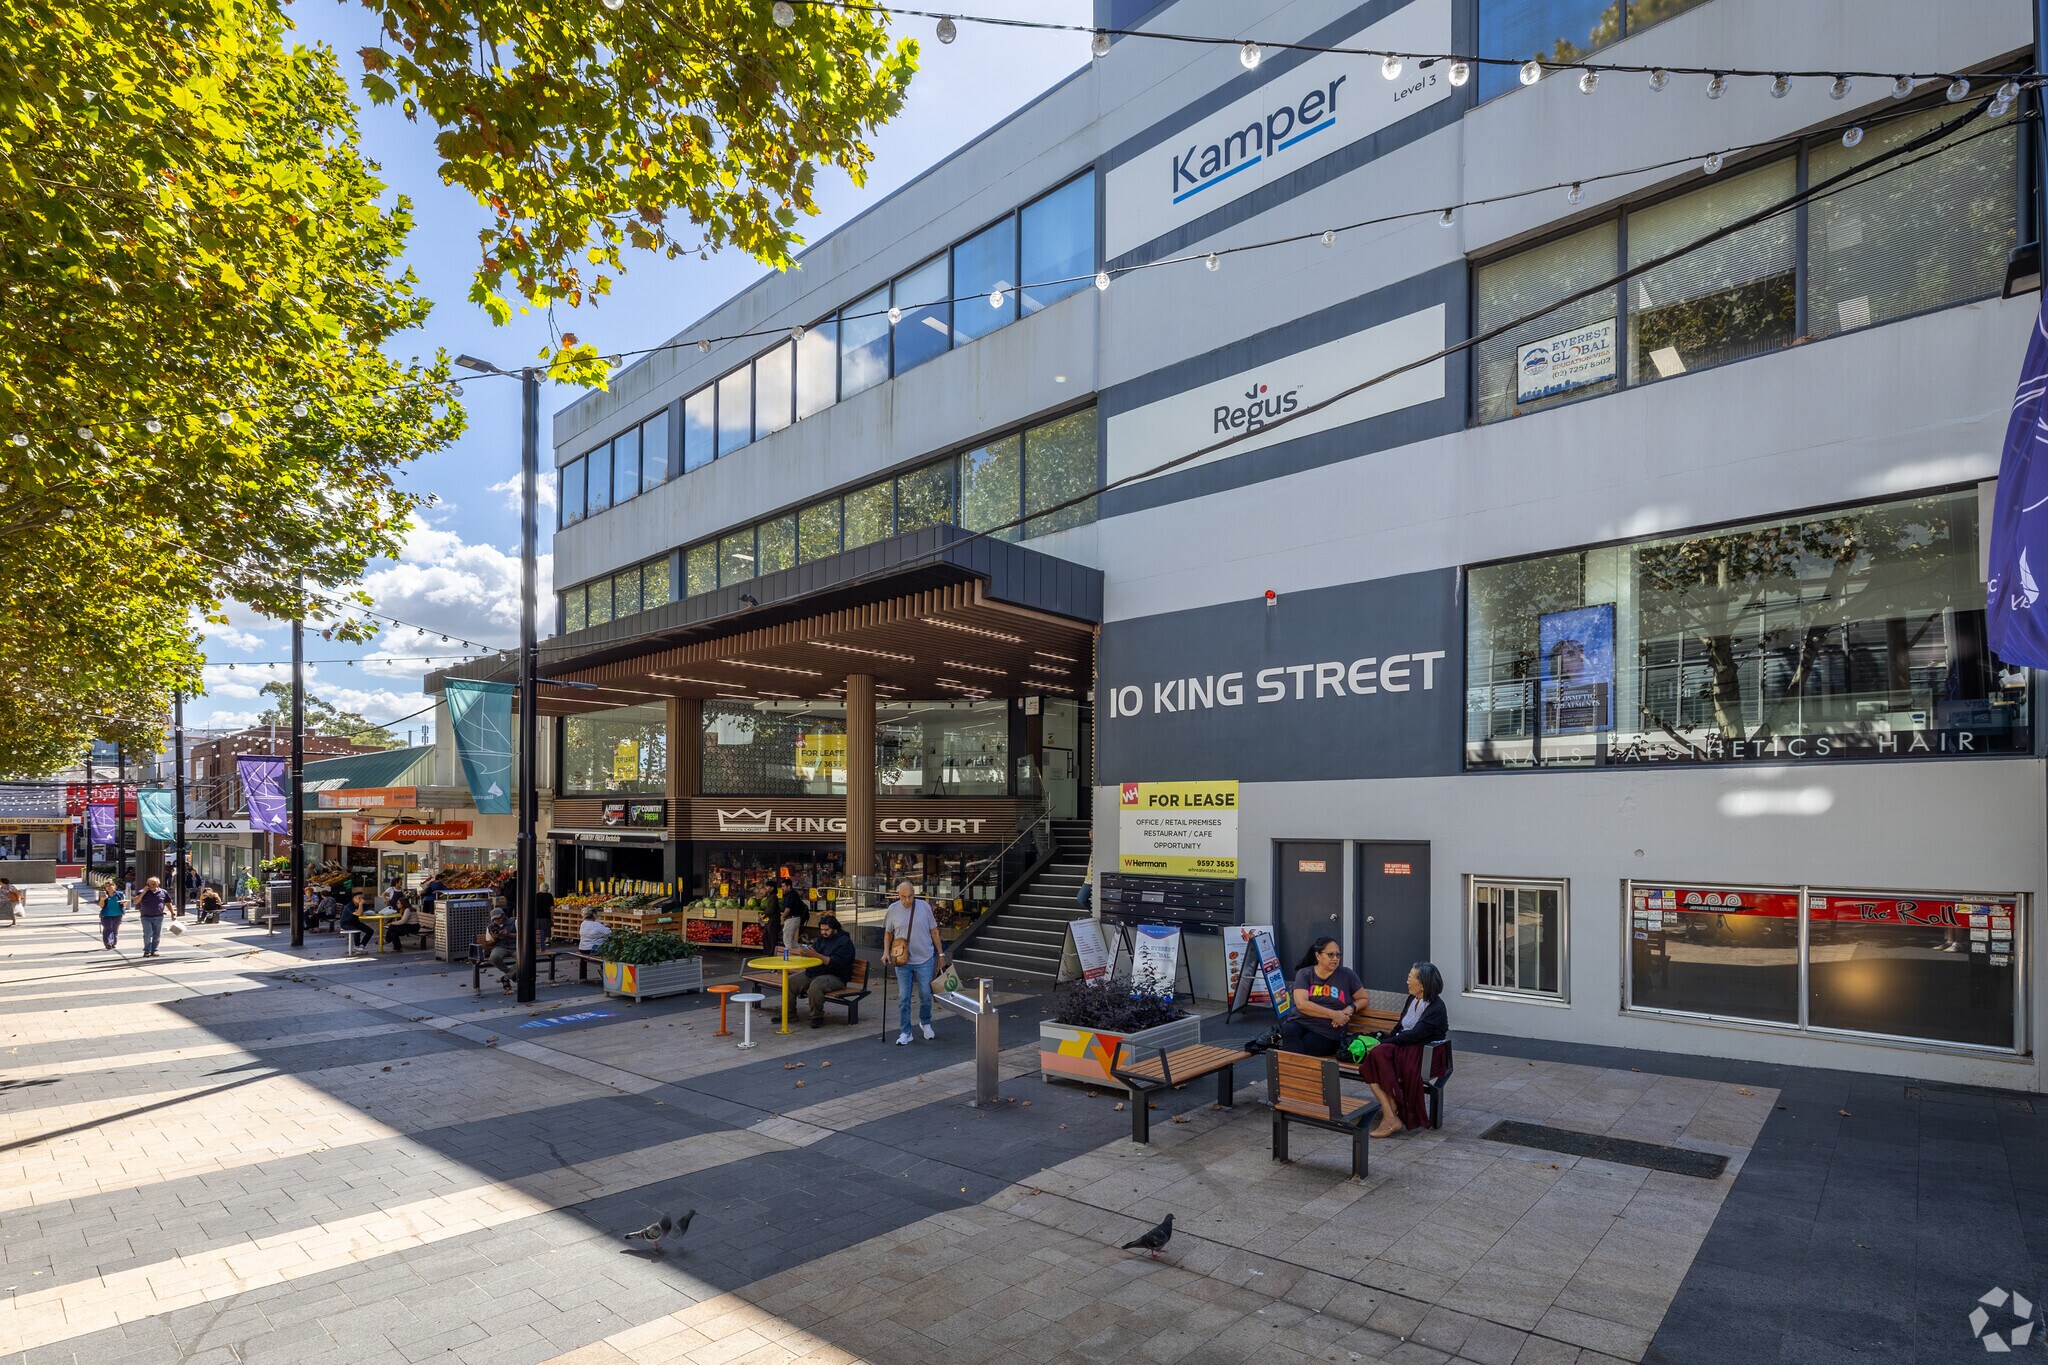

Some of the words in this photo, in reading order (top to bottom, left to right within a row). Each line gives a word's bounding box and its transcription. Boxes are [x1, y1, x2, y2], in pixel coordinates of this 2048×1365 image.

[1394, 76, 1425, 102] Level
[1429, 74, 1437, 86] 3
[1173, 74, 1346, 193] Kamper
[1551, 326, 1610, 351] EVEREST
[1551, 338, 1610, 363] GLOBAL
[1552, 370, 1567, 380] (02)
[1569, 364, 1588, 374] 7257
[1590, 357, 1611, 368] 8502
[1213, 390, 1298, 433] Regus
[1110, 685, 1143, 718] 10
[1154, 672, 1243, 714] KING
[1256, 650, 1446, 704] STREET
[1502, 747, 1582, 765] NAILS
[1624, 737, 1831, 762] AESTHETICS
[1879, 732, 1976, 754] HAIR
[1123, 787, 1139, 803] WH
[1149, 794, 1180, 807] FOR
[1184, 793, 1235, 807] LEASE
[644, 813, 659, 821] FRESH
[879, 818, 987, 834] COURT
[1854, 902, 1888, 920] The
[1896, 901, 1961, 927] Roll
